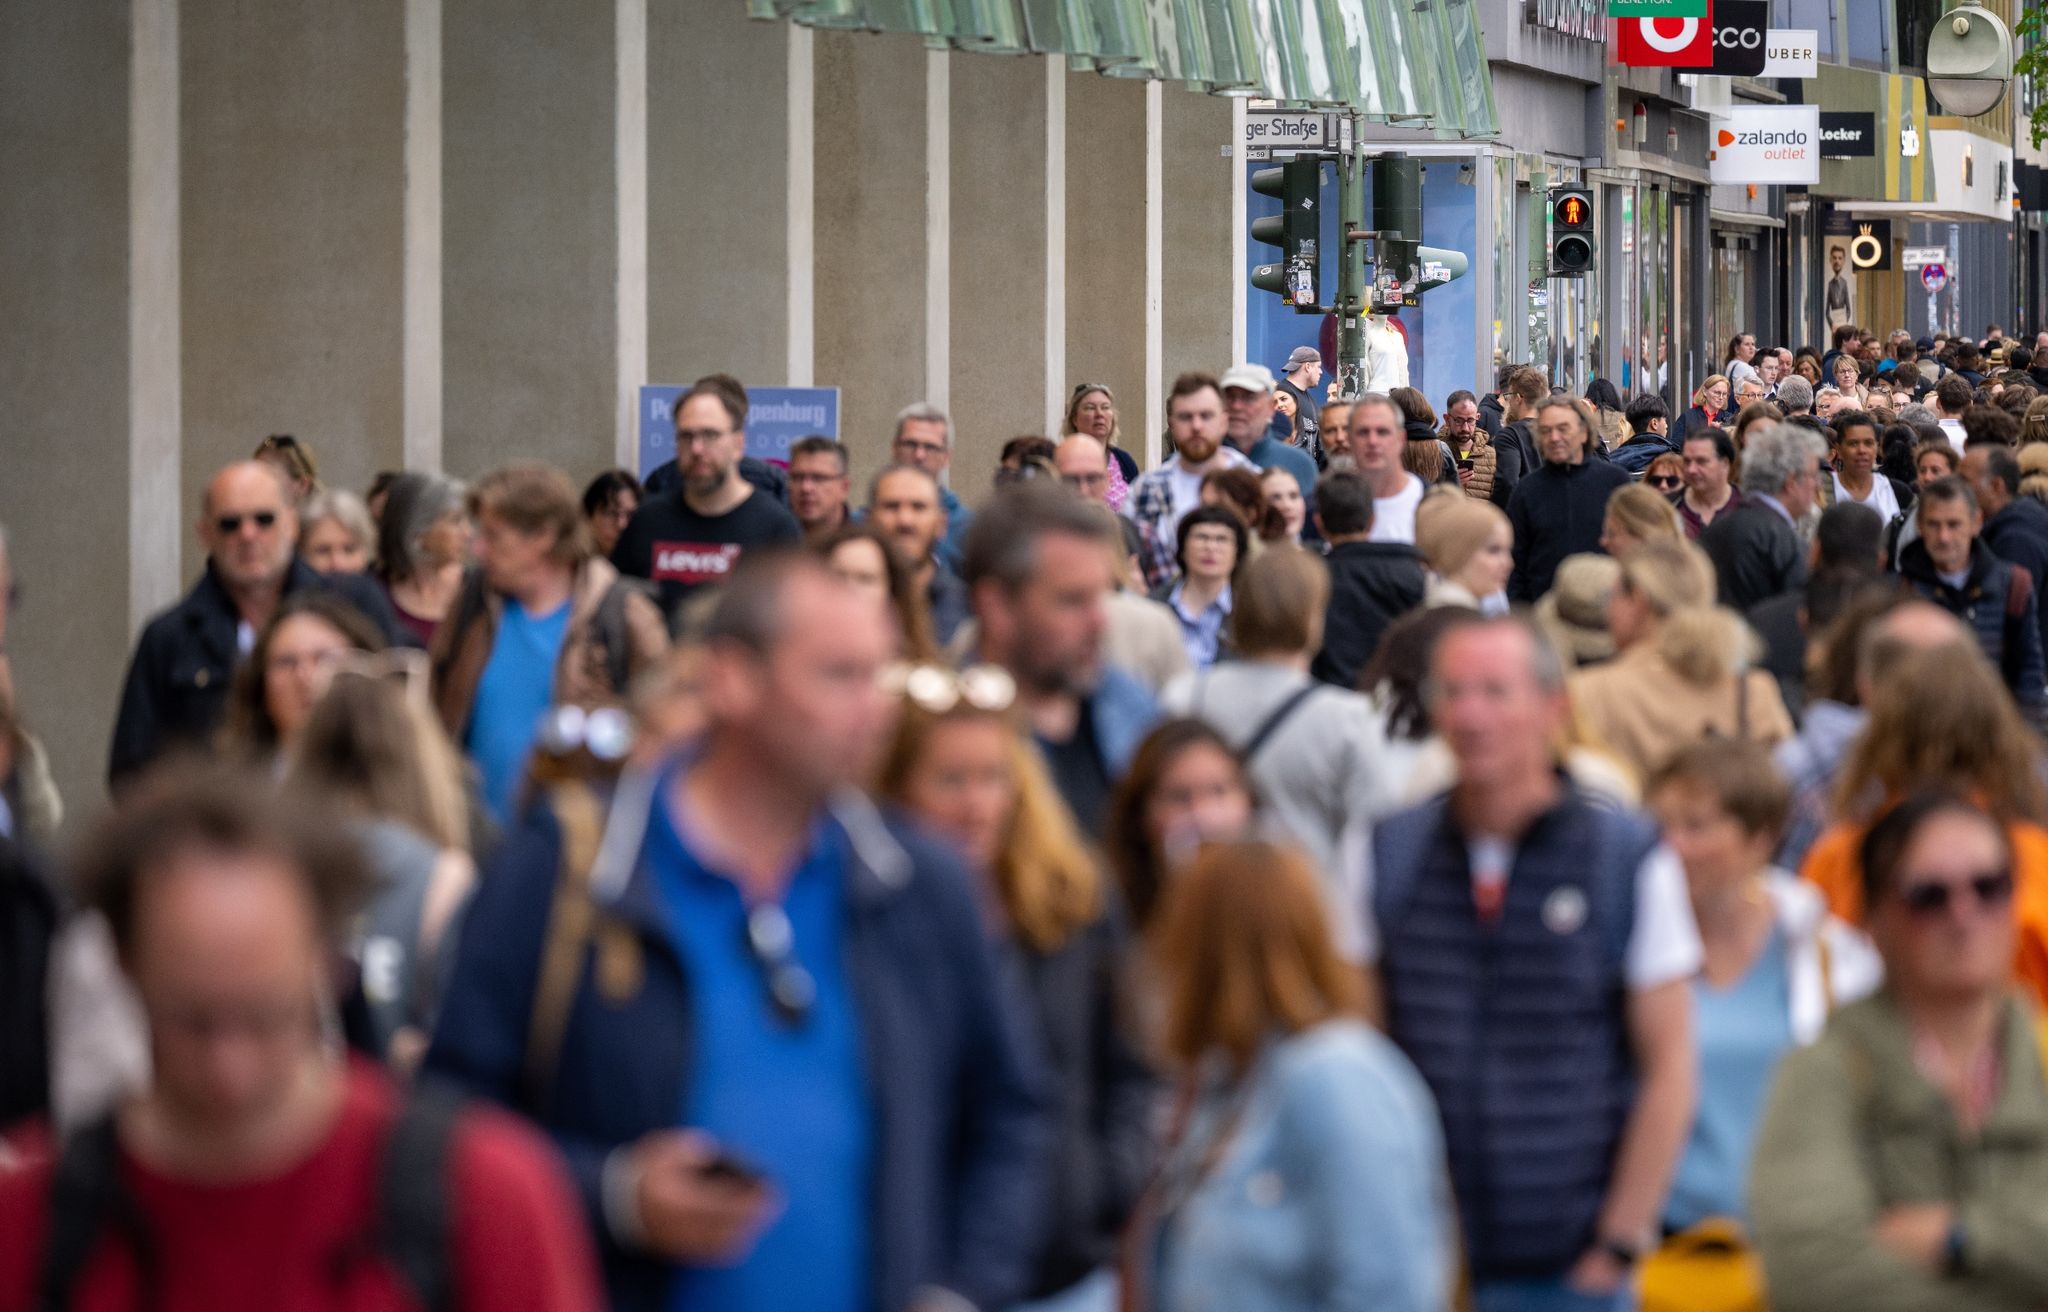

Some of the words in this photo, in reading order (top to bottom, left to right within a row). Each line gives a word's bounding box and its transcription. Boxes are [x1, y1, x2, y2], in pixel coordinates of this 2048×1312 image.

[1768, 48, 1812, 60] UBER
[1738, 129, 1807, 145] zalando
[1819, 128, 1862, 141] Locker
[1764, 148, 1806, 160] outlet
